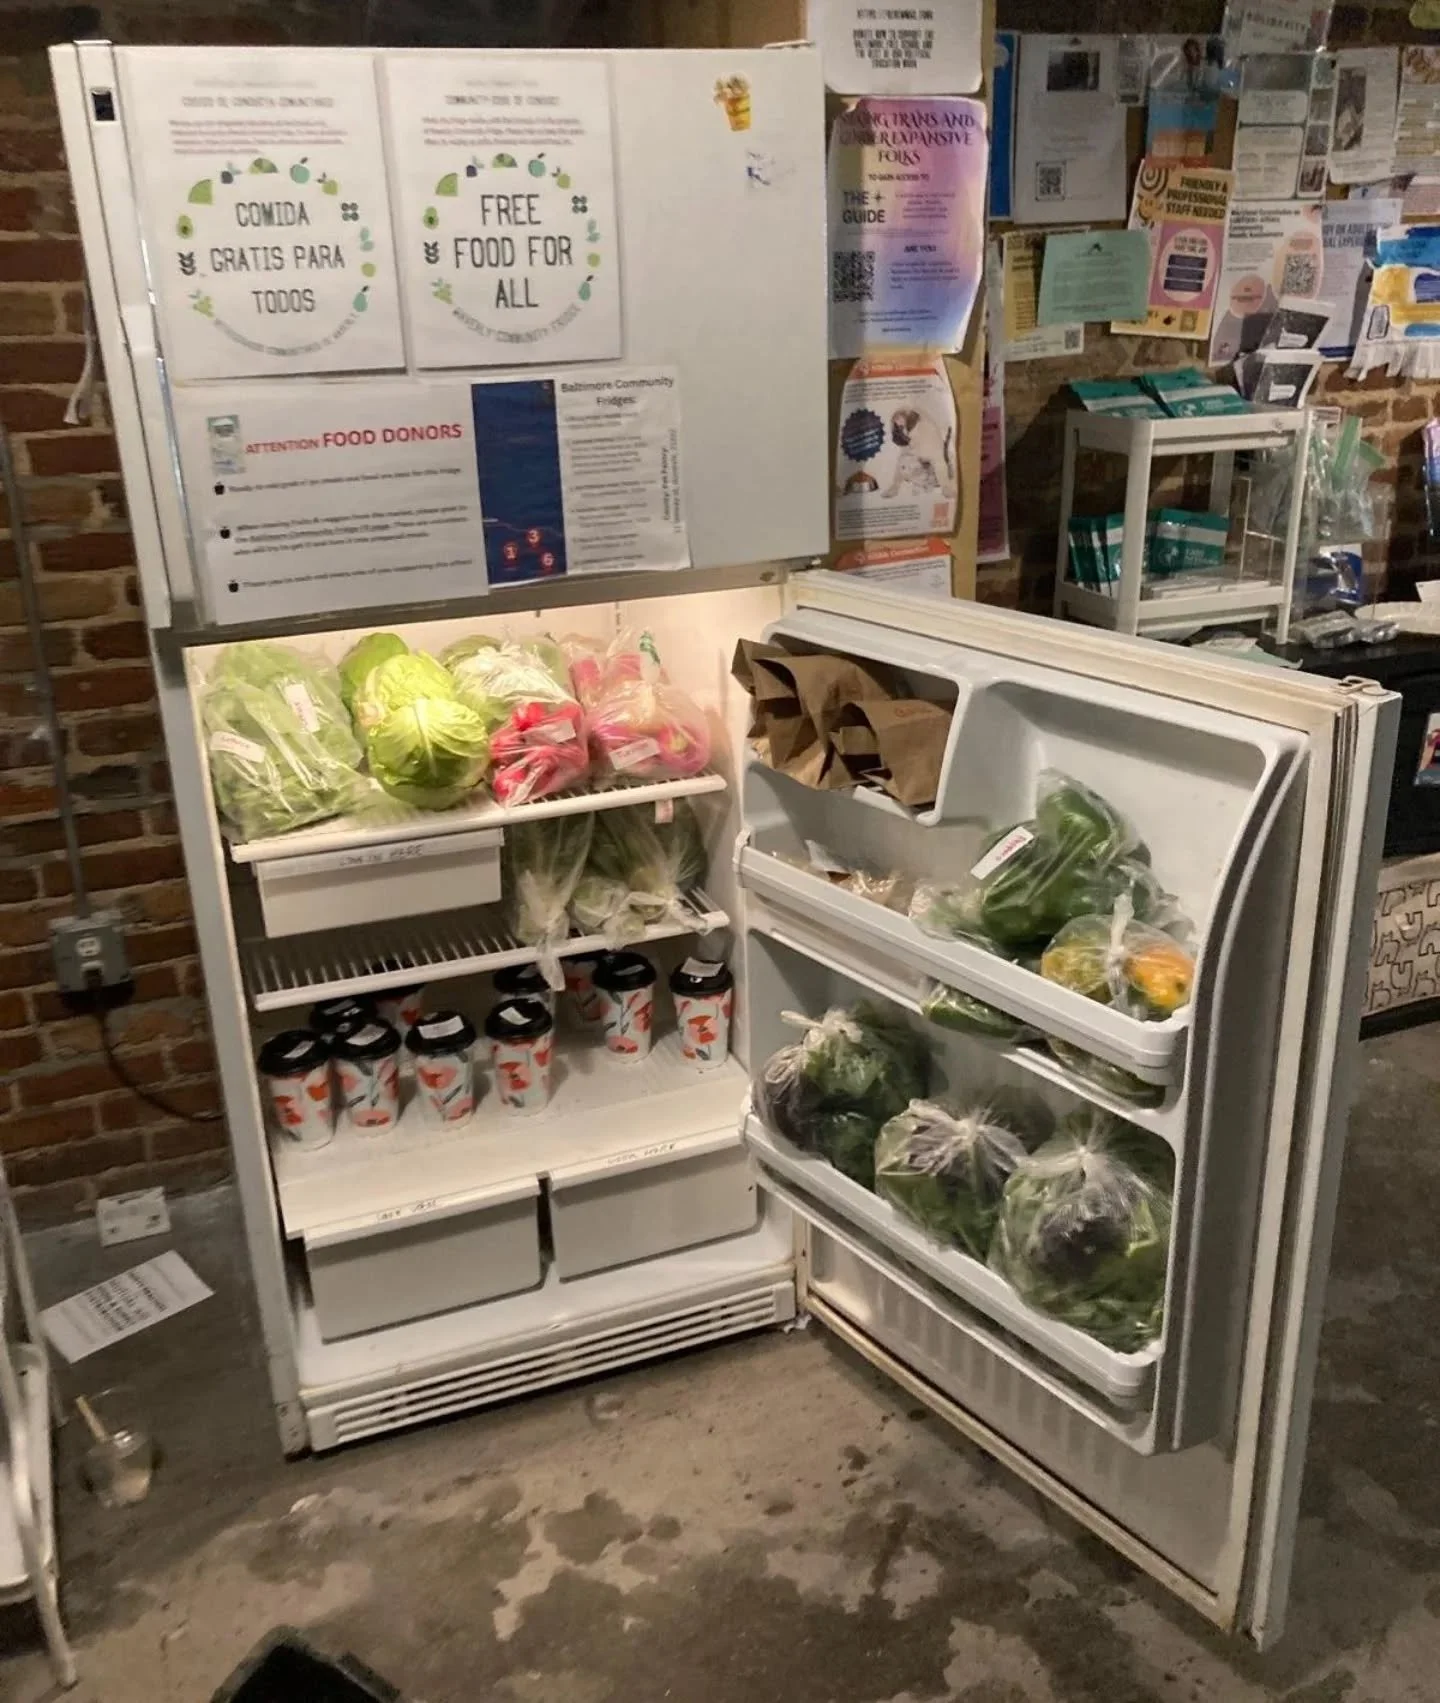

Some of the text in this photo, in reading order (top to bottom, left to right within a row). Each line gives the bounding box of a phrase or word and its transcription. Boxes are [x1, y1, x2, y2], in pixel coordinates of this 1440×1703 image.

[892, 110, 939, 129] TRANS
[940, 111, 976, 129] AND
[877, 149, 921, 166] FOLKS
[480, 194, 542, 226] FREE
[842, 190, 869, 205] THE
[235, 201, 310, 228] COMIDA
[842, 209, 886, 224] GUIDE
[1166, 202, 1226, 219] STAFF NEEDED
[209, 245, 345, 273] GRATIS PARA
[454, 235, 573, 269] FOOD FOR
[252, 289, 316, 314] TODOS
[495, 277, 539, 309] ALL
[560, 376, 675, 394] Baltimore Community
[246, 423, 463, 455] ATTENTION FOOD DONORS
